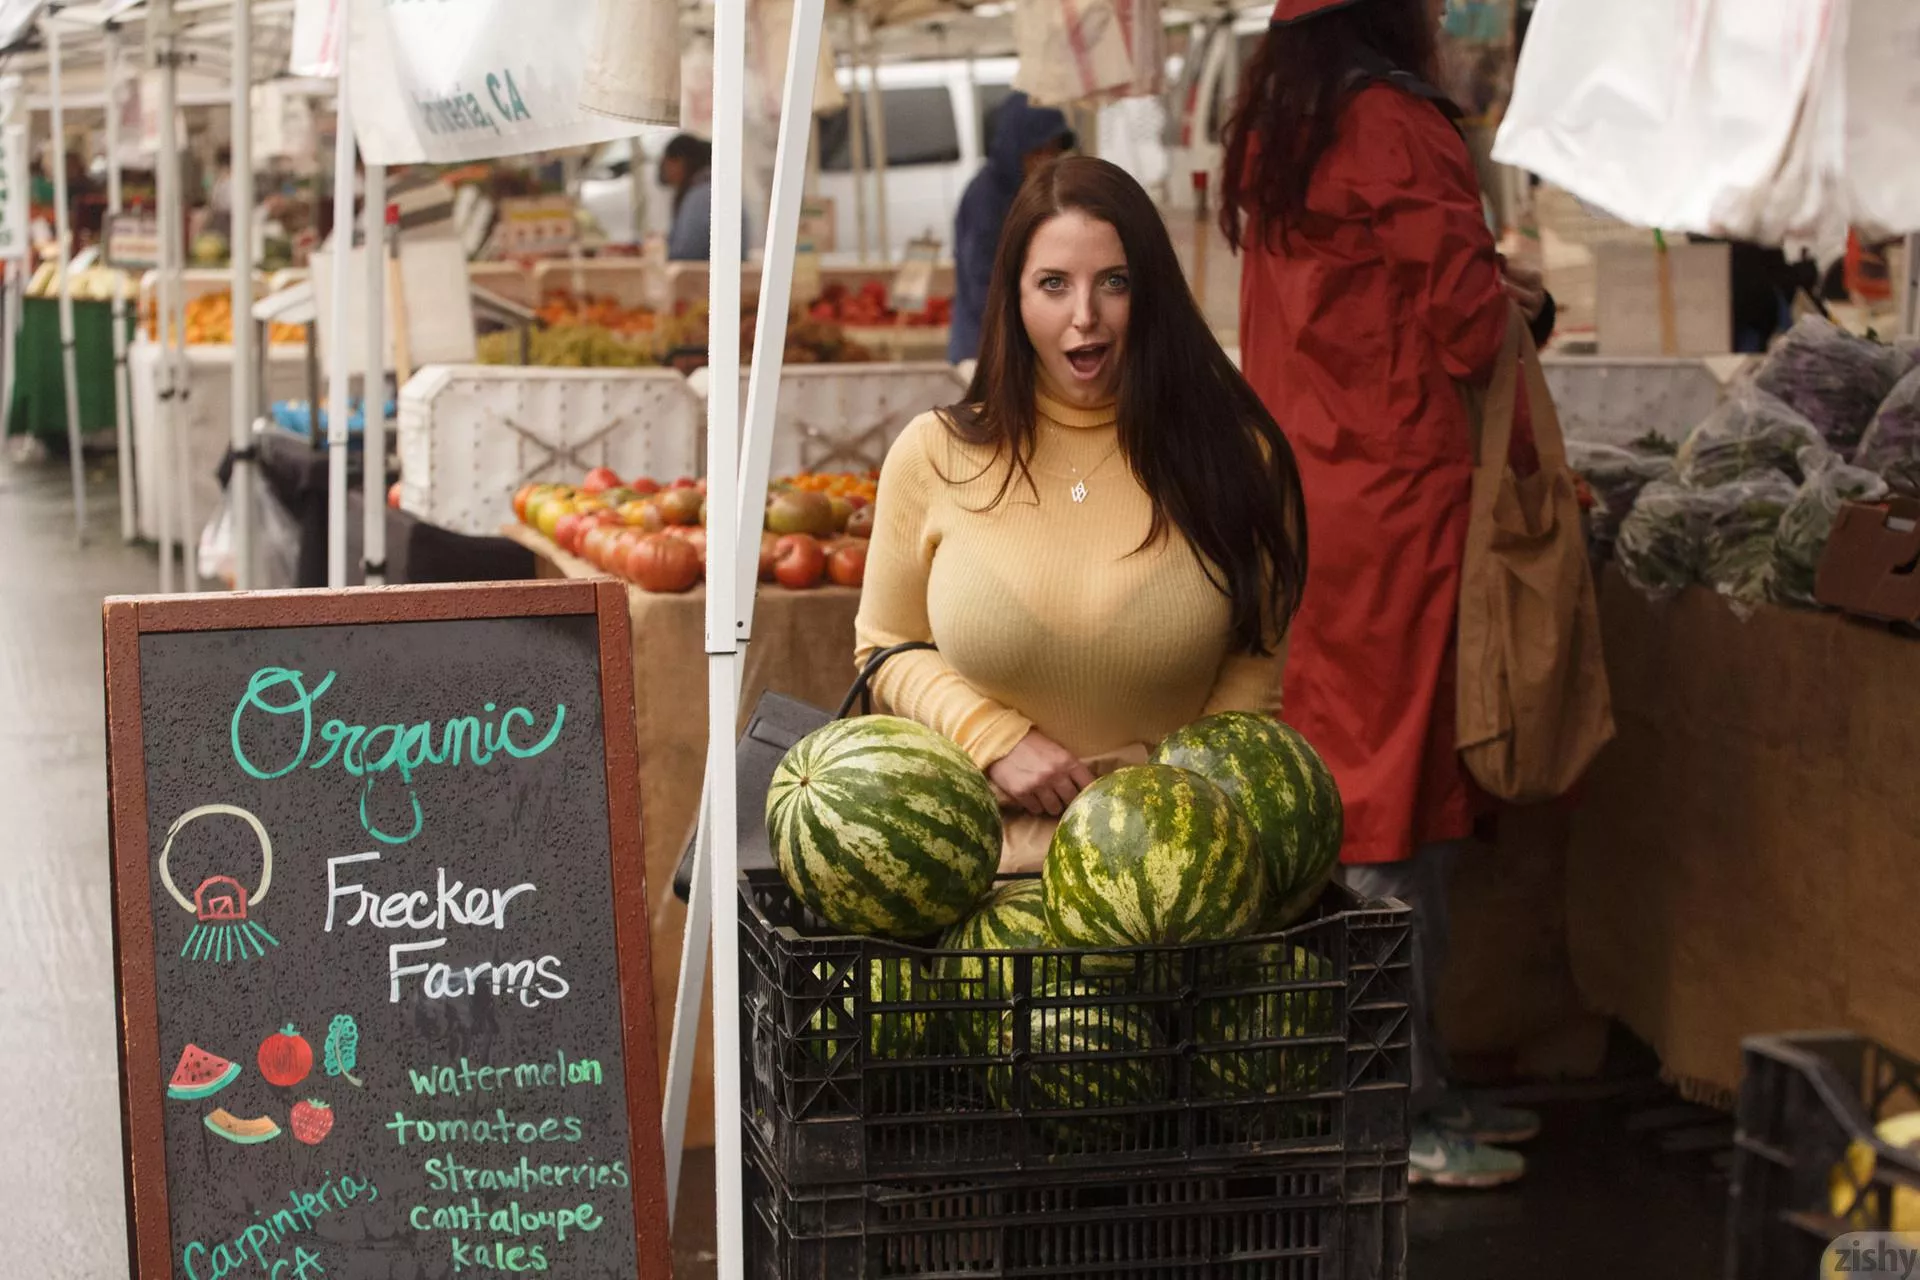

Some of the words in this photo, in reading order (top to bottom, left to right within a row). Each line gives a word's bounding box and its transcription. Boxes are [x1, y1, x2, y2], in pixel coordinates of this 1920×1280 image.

[486, 69, 531, 123] CA
[231, 666, 566, 844] Organic
[324, 851, 538, 933] Frecker
[389, 936, 570, 1007] Farms
[408, 1049, 603, 1097] watermelon
[385, 1108, 583, 1146] tomatoes
[183, 1168, 379, 1280] Carpinteria,
[409, 1196, 604, 1242] cantaloupe
[450, 1236, 549, 1273] kales
